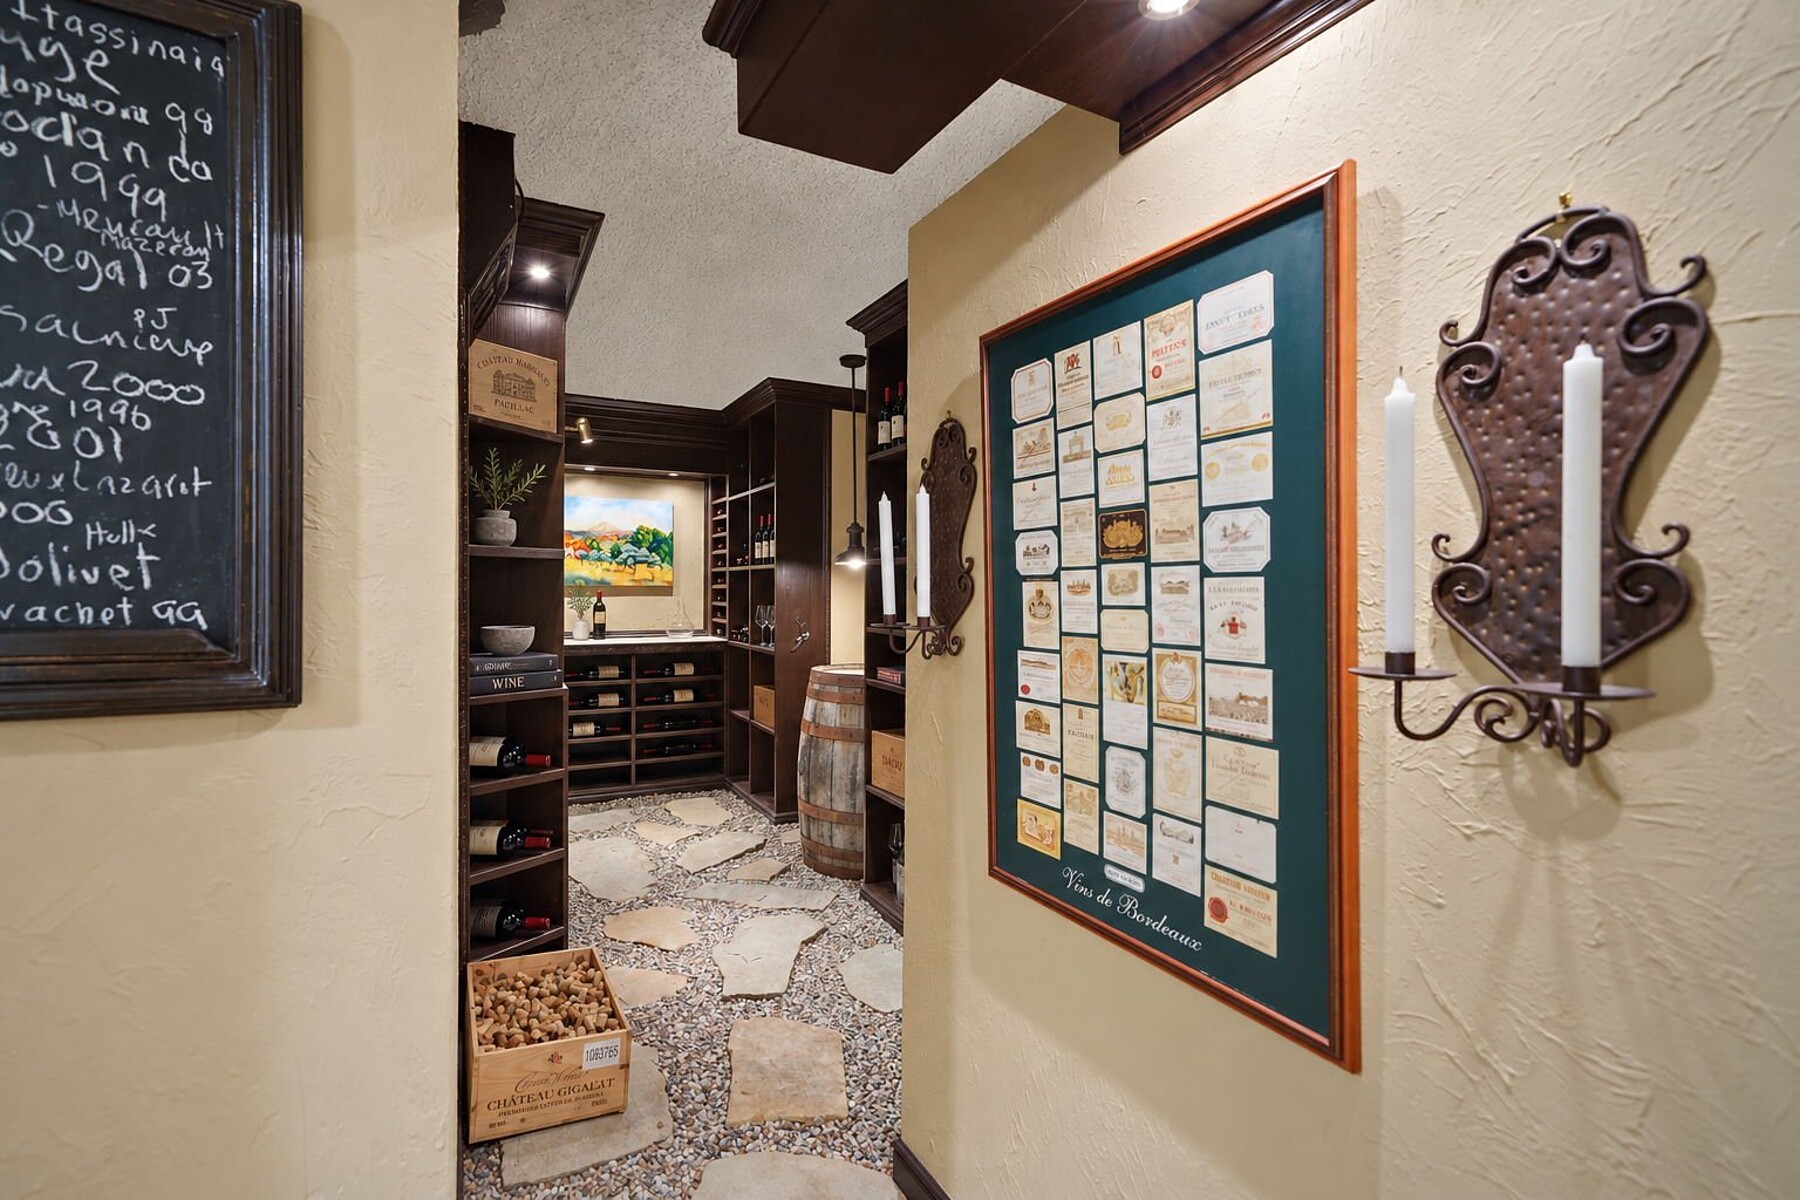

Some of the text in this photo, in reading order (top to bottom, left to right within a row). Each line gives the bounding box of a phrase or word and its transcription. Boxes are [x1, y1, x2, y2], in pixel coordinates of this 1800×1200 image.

[66, 359, 206, 405] 2000
[69, 398, 152, 431] 1996
[492, 676, 525, 690] WINE
[1062, 866, 1094, 899] Vins
[1096, 888, 1113, 908] de
[1116, 893, 1203, 952] Bordeaux
